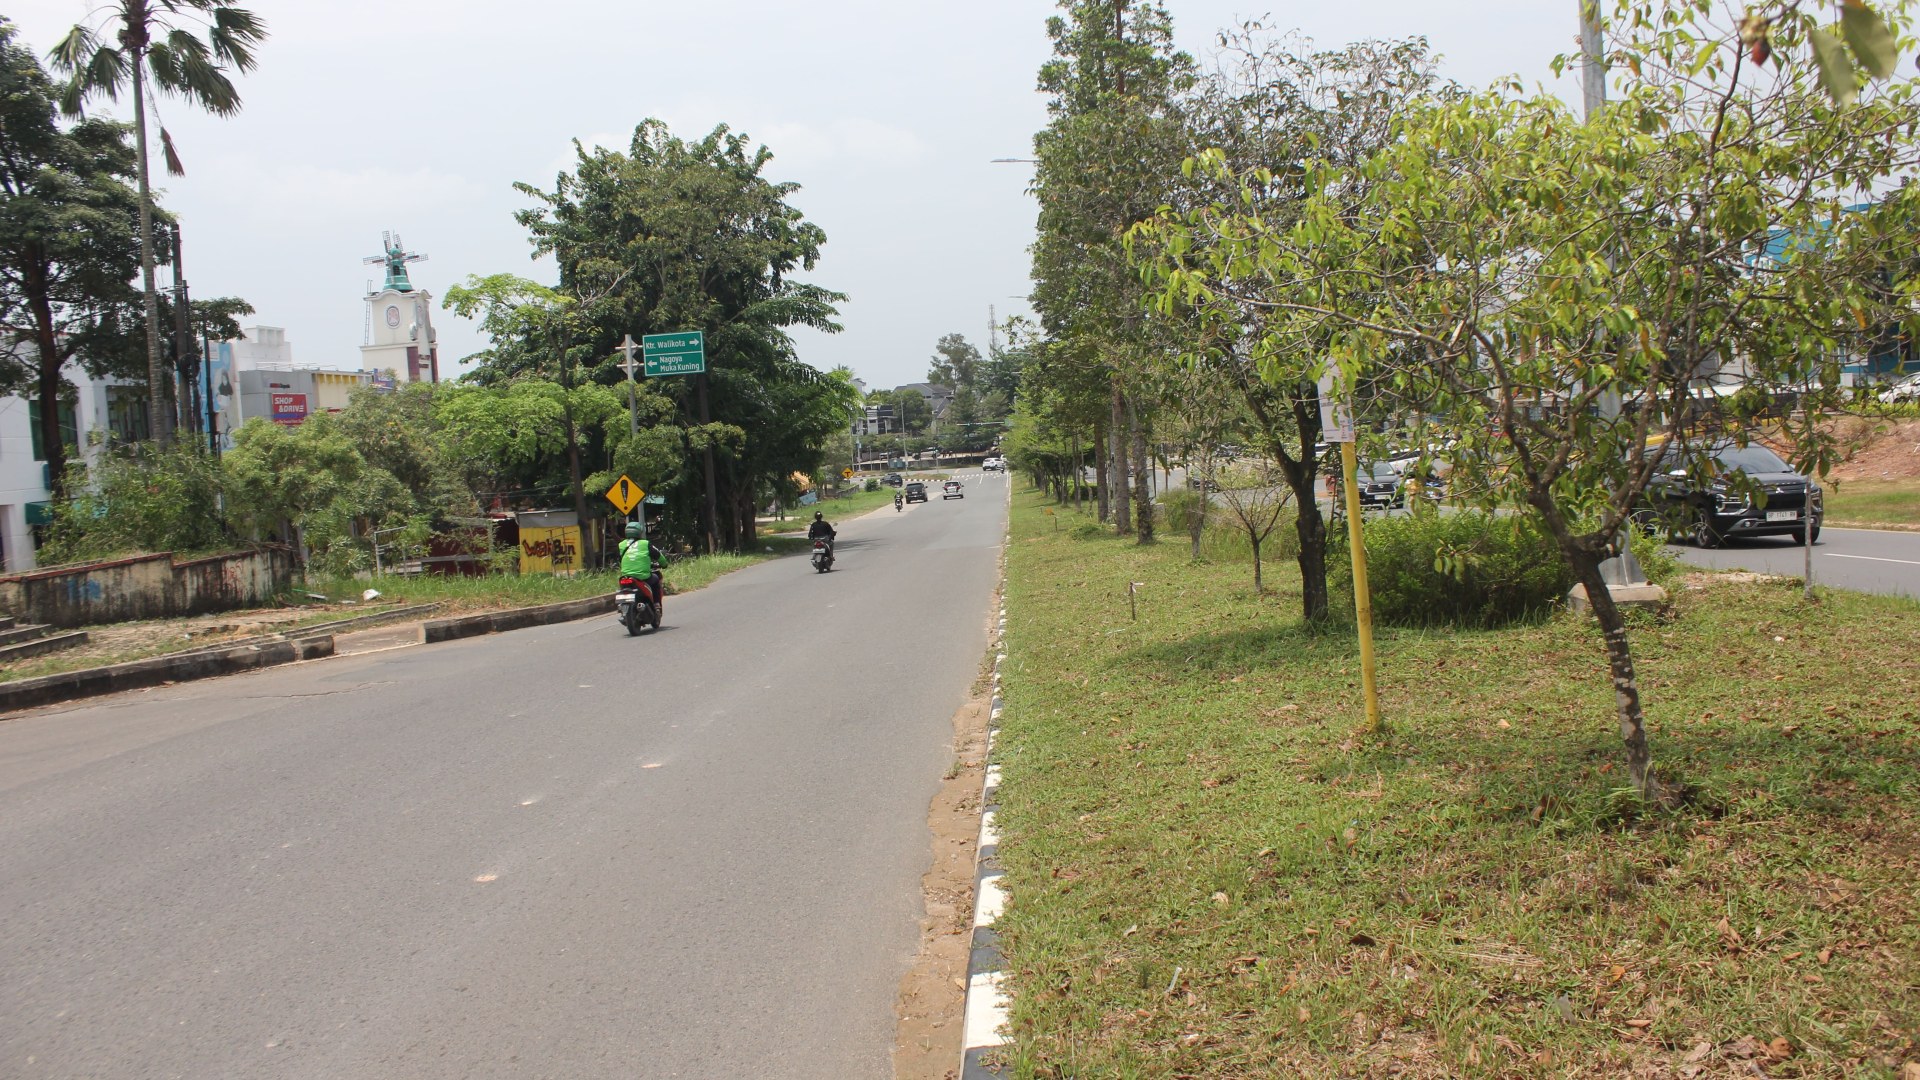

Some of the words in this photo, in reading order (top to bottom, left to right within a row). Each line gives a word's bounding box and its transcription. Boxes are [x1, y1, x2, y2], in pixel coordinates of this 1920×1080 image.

[657, 340, 686, 349] Walikota
[660, 356, 683, 364] Nagoya
[677, 363, 700, 371] Kuning
[274, 397, 293, 405] SHOP
